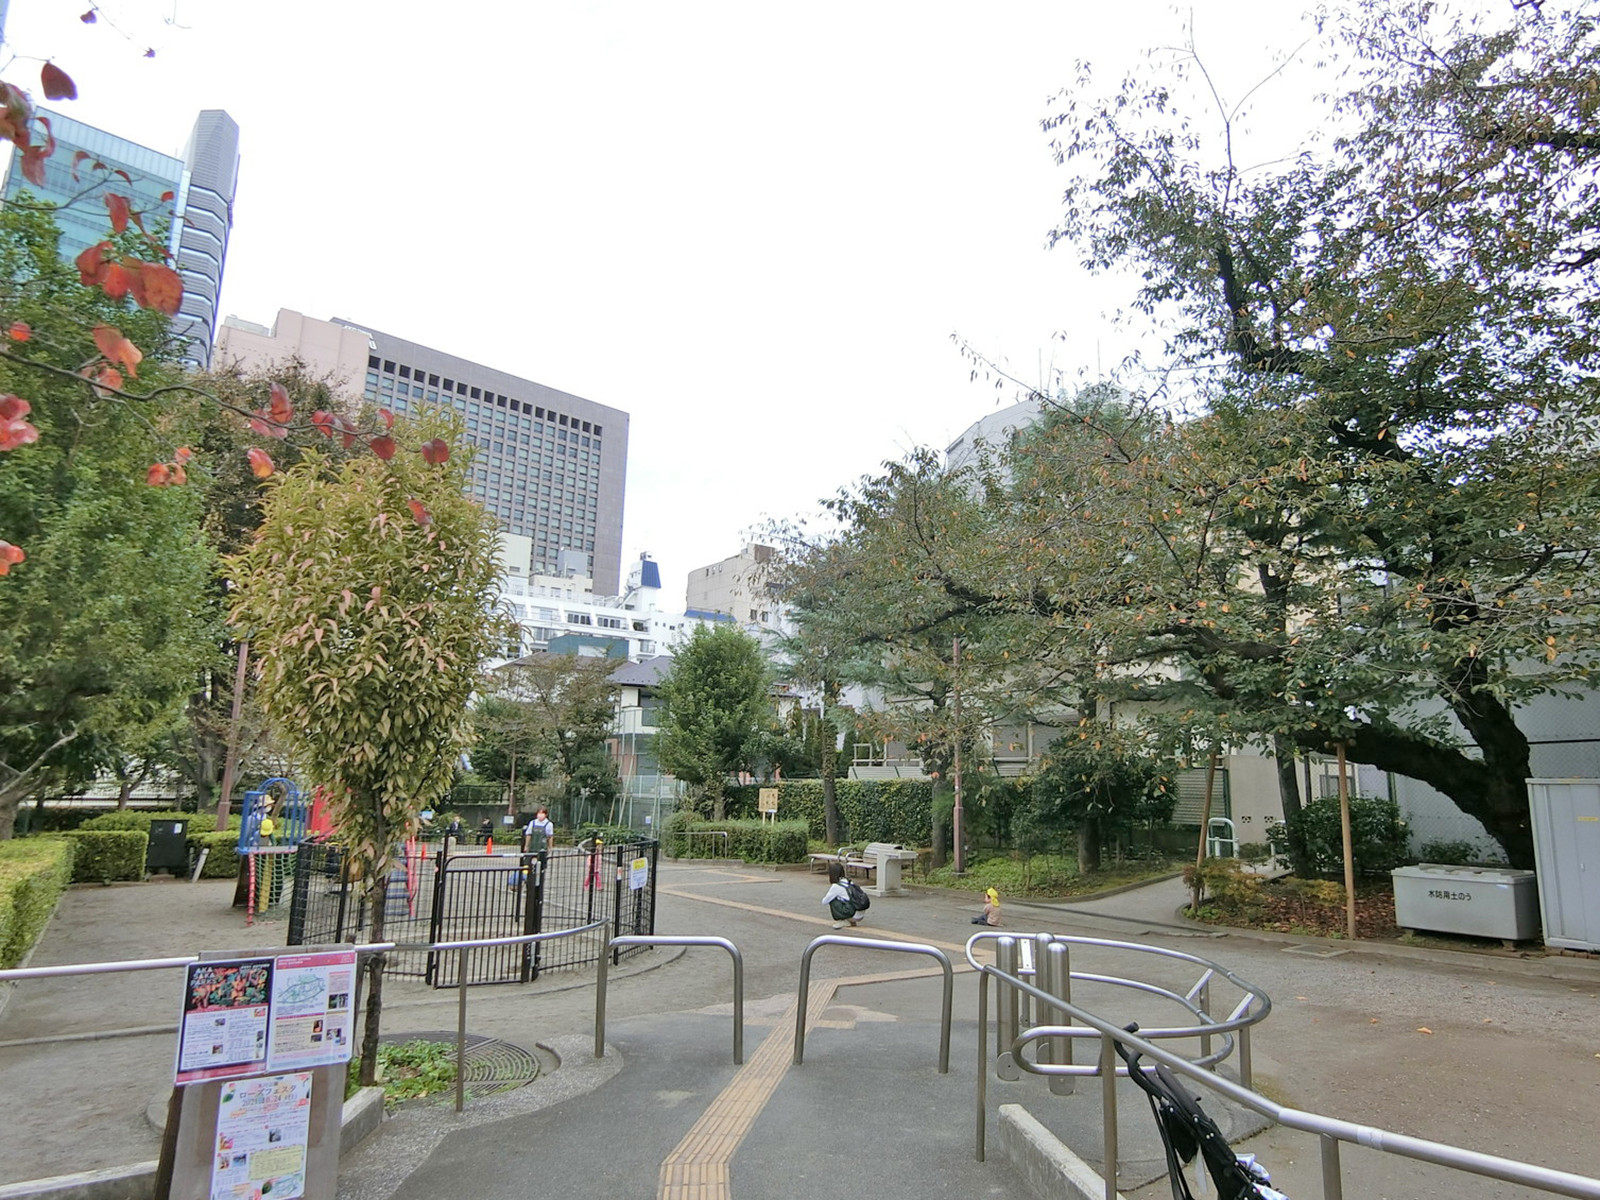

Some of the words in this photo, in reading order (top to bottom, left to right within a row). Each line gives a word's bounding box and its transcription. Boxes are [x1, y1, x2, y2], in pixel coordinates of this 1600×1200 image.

[1428, 890, 1472, 901] 水防用土のう
[239, 1085, 297, 1098] ローズフェスタ
